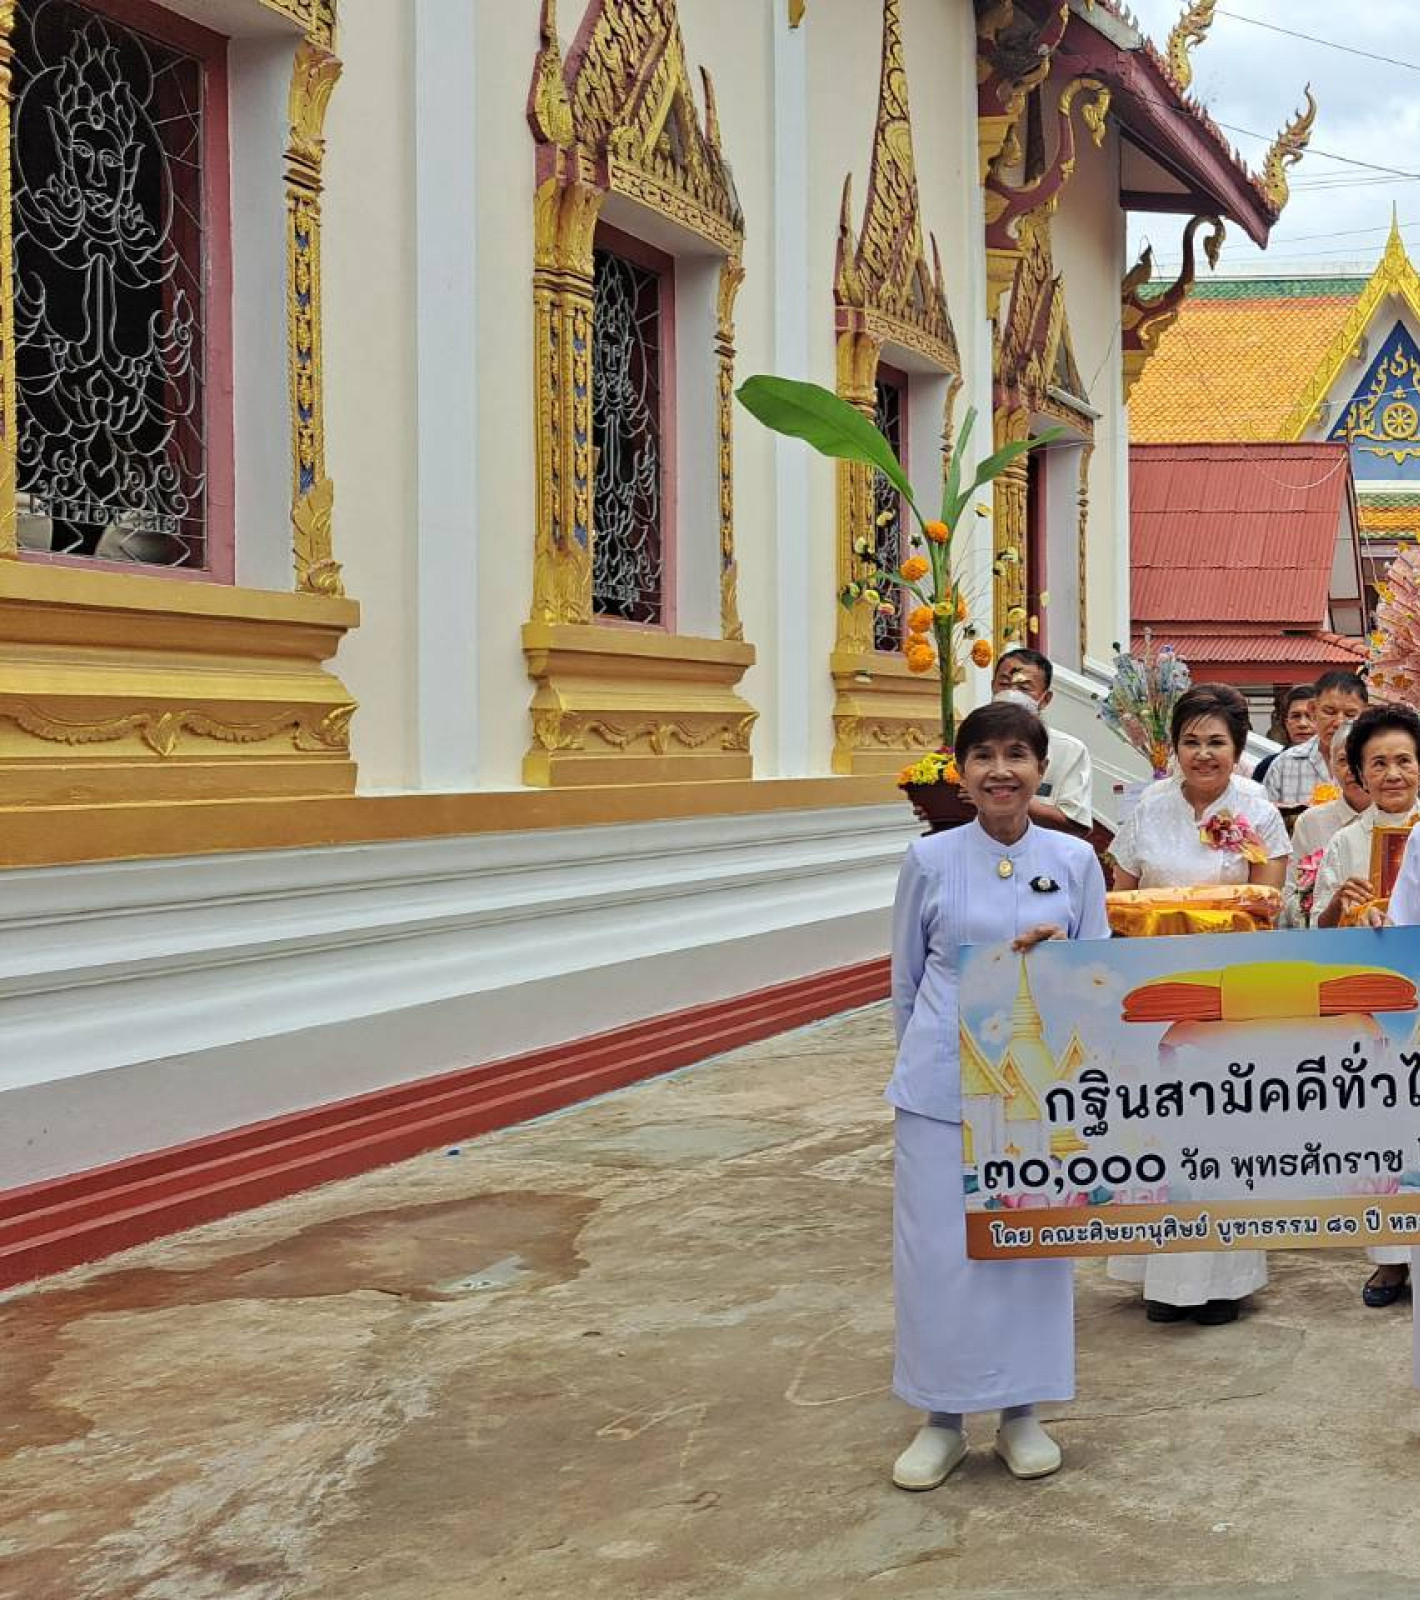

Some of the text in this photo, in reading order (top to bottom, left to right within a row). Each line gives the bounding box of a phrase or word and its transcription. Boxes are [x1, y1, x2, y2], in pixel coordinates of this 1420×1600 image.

[984, 1154, 1166, 1194] ๓๐,๐๐๐
[1180, 1147, 1219, 1181] วัด
[1230, 1142, 1403, 1191] พุทธศักราช
[991, 1221, 1032, 1247] โดย
[1041, 1213, 1209, 1247] คณะศิษยานุศิษย์
[1216, 1216, 1318, 1244] บูชาธรรม
[1326, 1215, 1358, 1233] ๘๑
[1365, 1207, 1381, 1232] ปี
